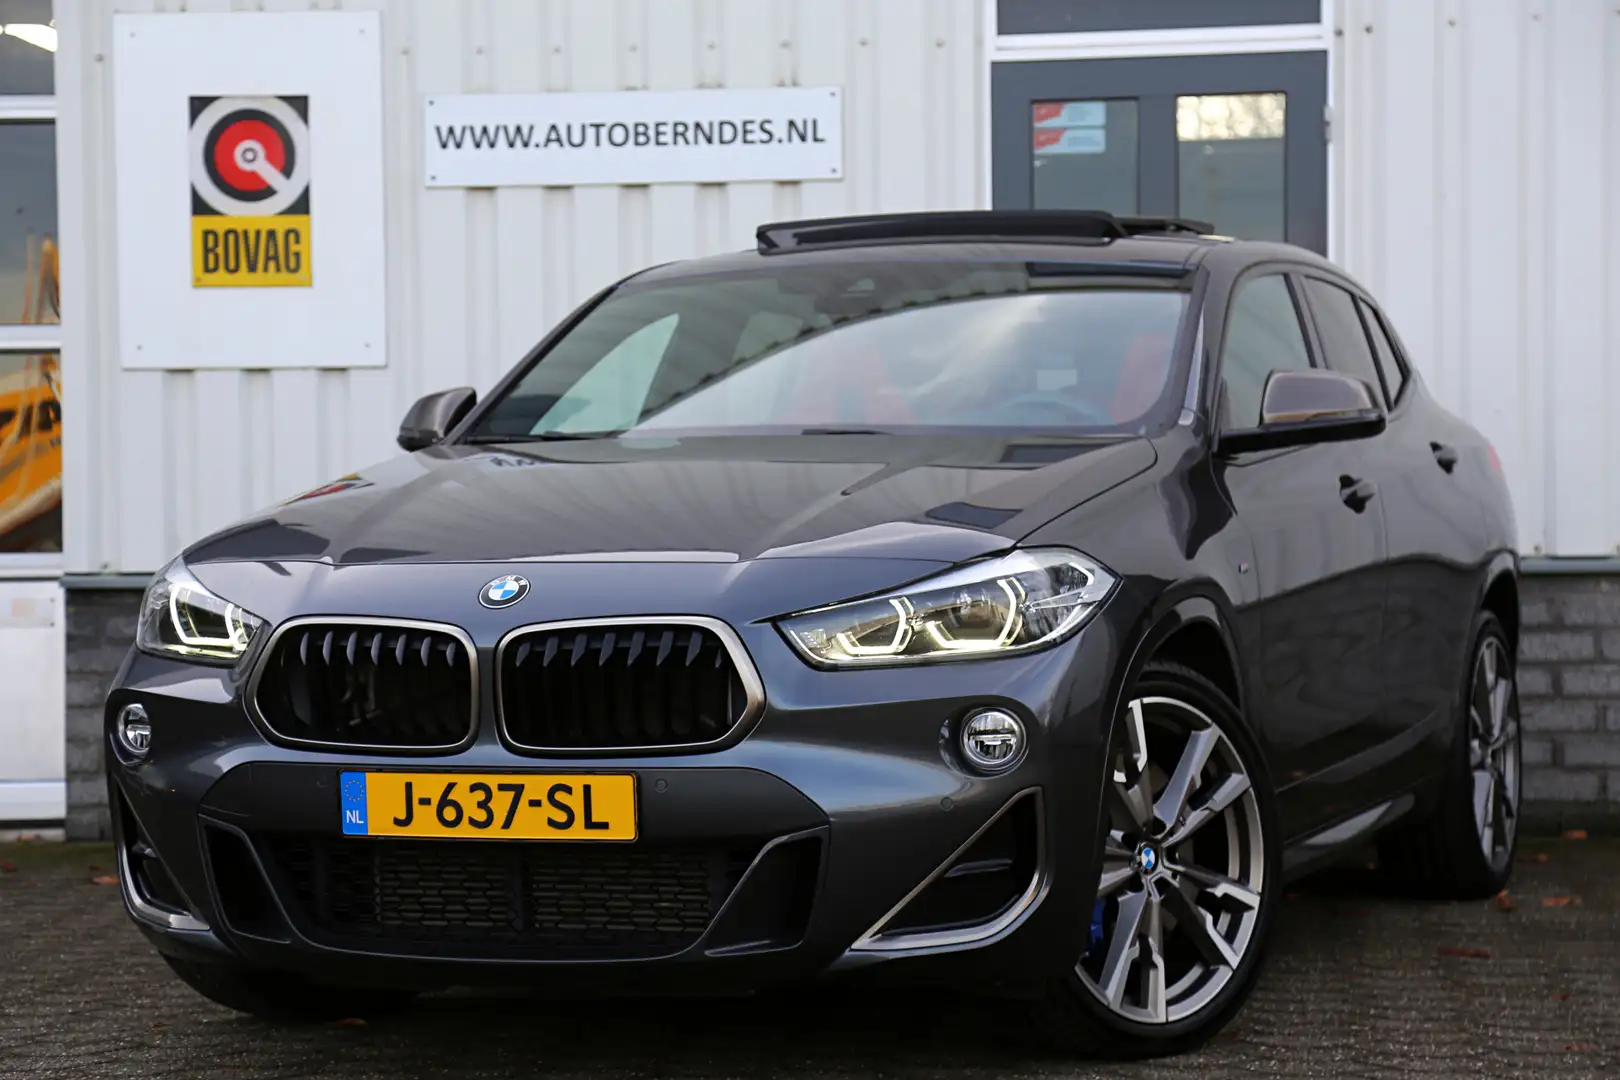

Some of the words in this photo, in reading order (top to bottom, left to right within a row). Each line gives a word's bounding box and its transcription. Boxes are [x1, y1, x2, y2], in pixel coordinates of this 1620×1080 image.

[435, 118, 826, 149] WWW.AUTOBERNDES.NL
[202, 227, 302, 274] BOVAG
[345, 810, 364, 824] NL
[393, 781, 610, 830] J-637-SL
